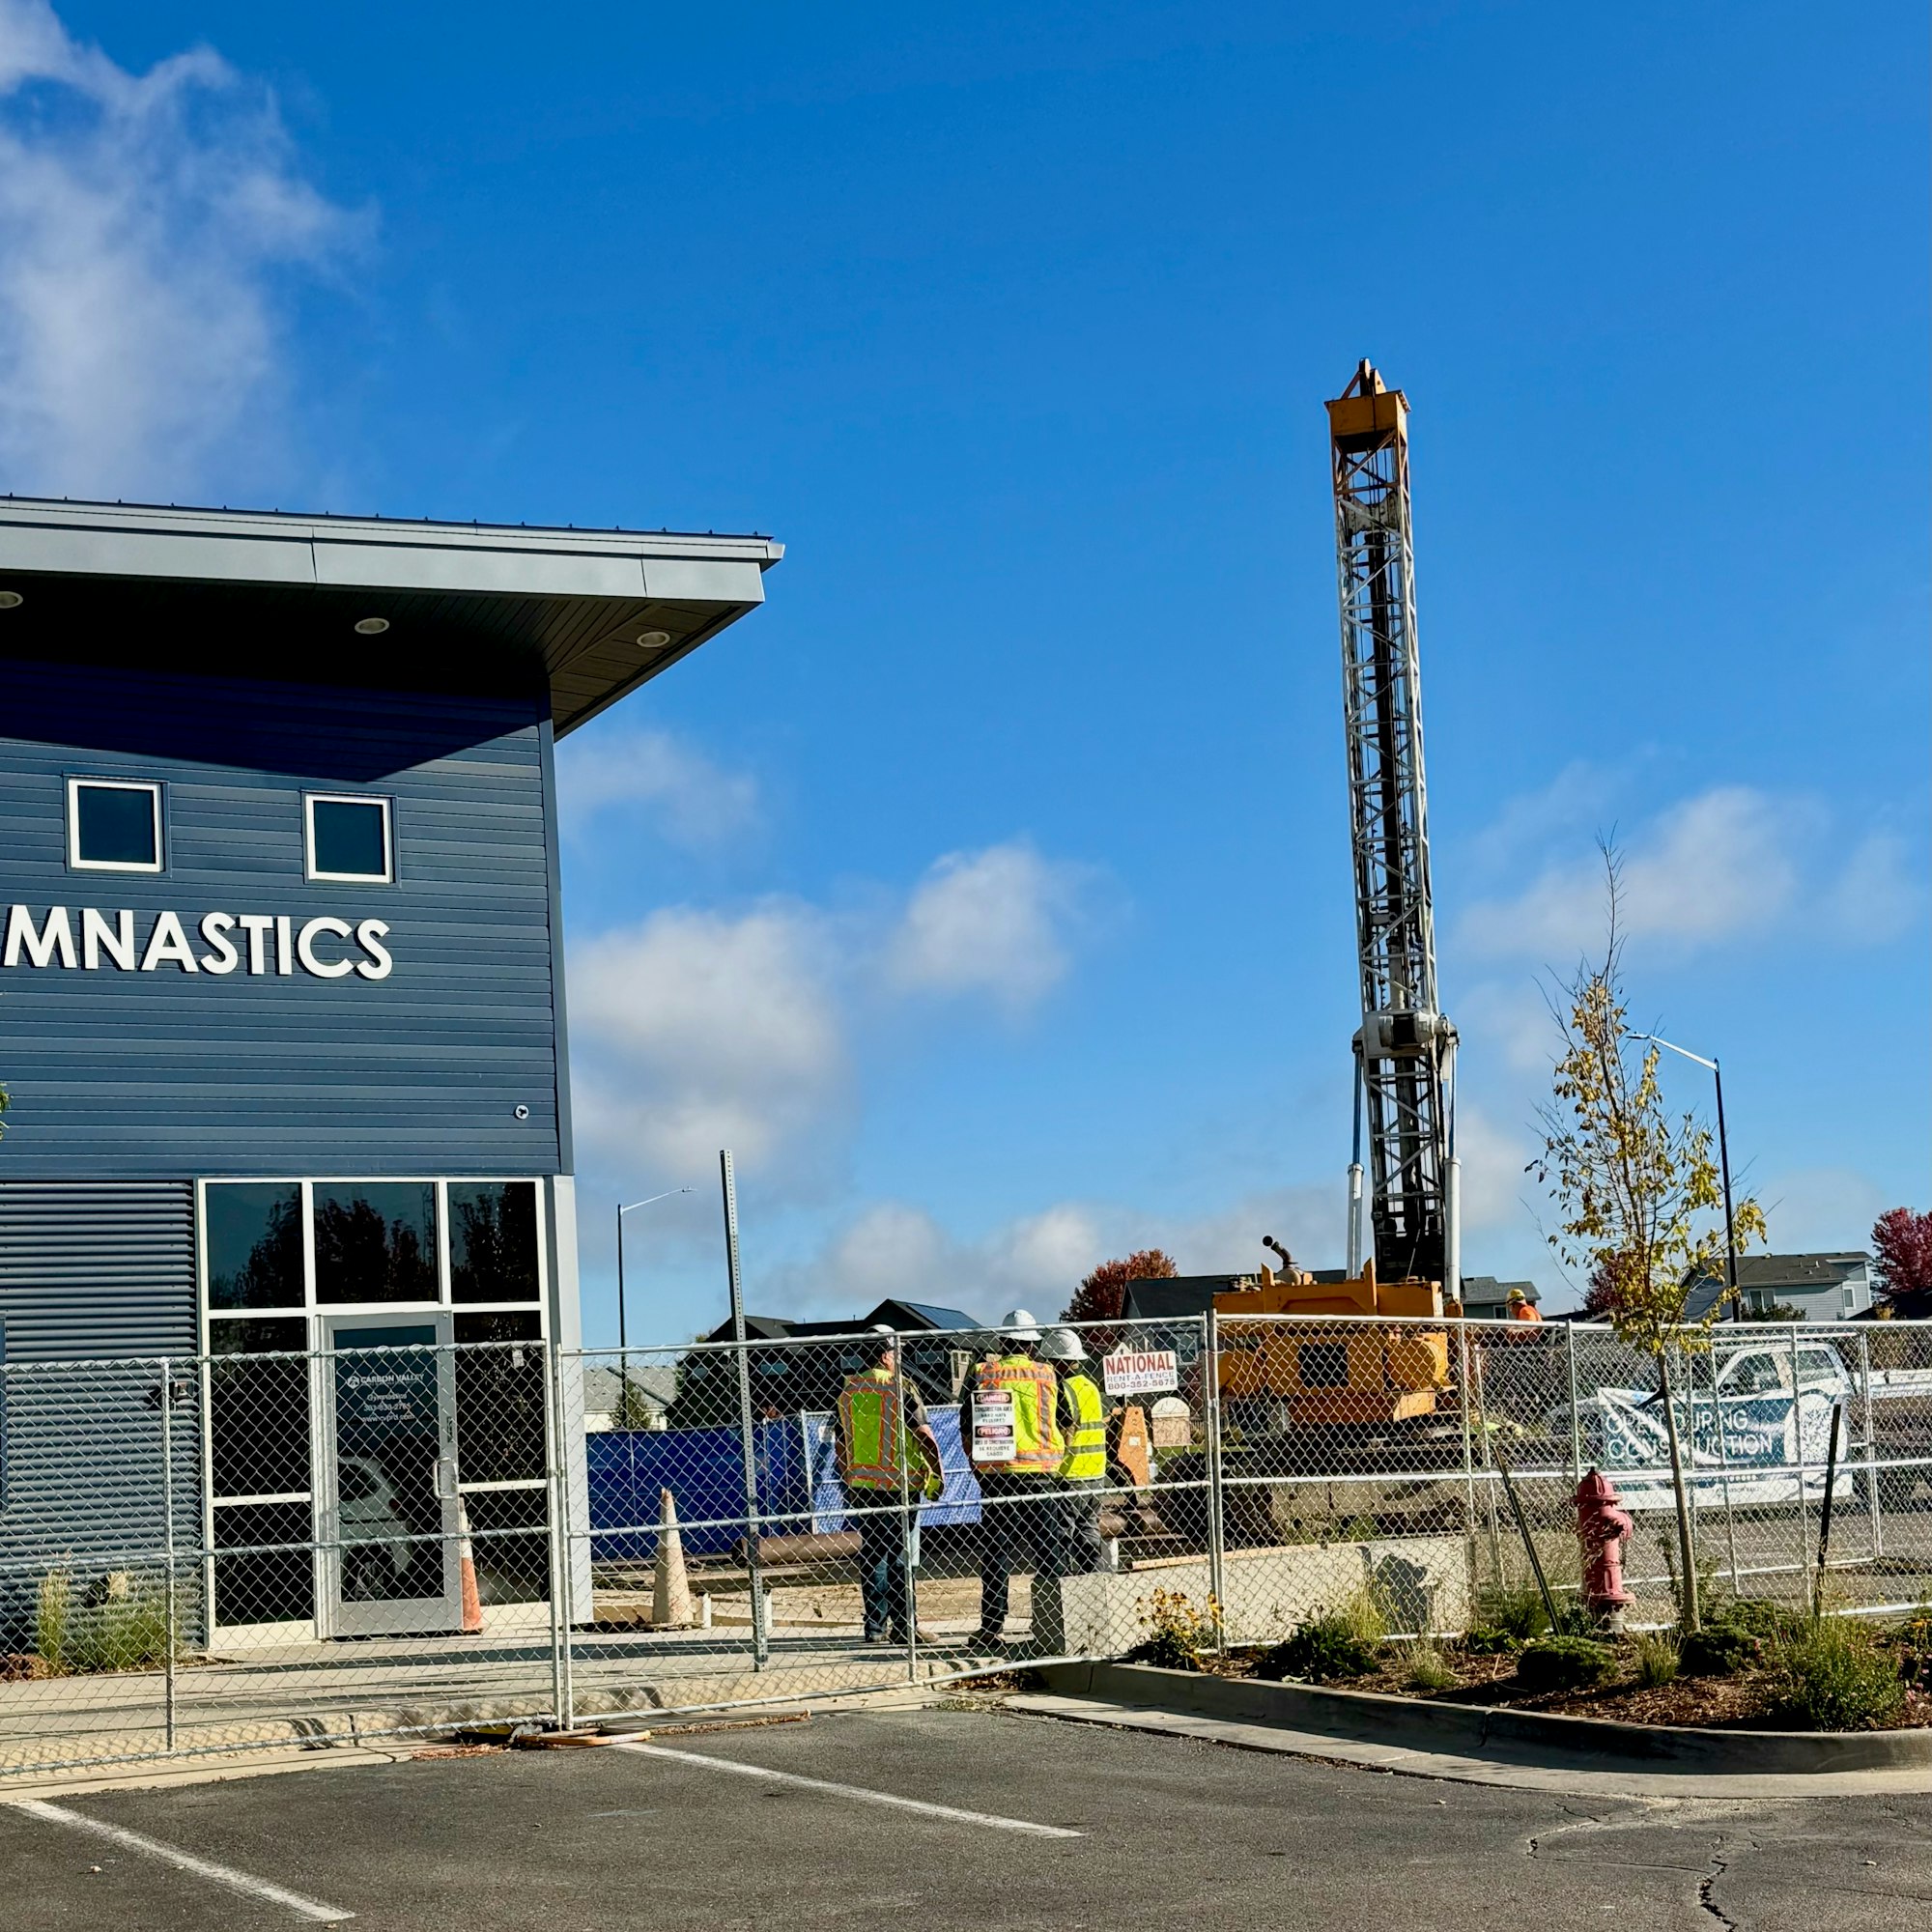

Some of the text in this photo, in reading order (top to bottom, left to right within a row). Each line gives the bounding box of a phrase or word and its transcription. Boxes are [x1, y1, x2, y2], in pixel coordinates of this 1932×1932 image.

[4, 905, 392, 980] MNASTICS
[1105, 1353, 1174, 1375] NATIONAL
[397, 1373, 425, 1381] VALLEY
[1107, 1372, 1174, 1382] RENT-A-FENCE
[980, 1427, 1009, 1435] PELIGRO
[1674, 1409, 1748, 1432] DURNG
[1607, 1434, 1773, 1459] CONSUCTION
